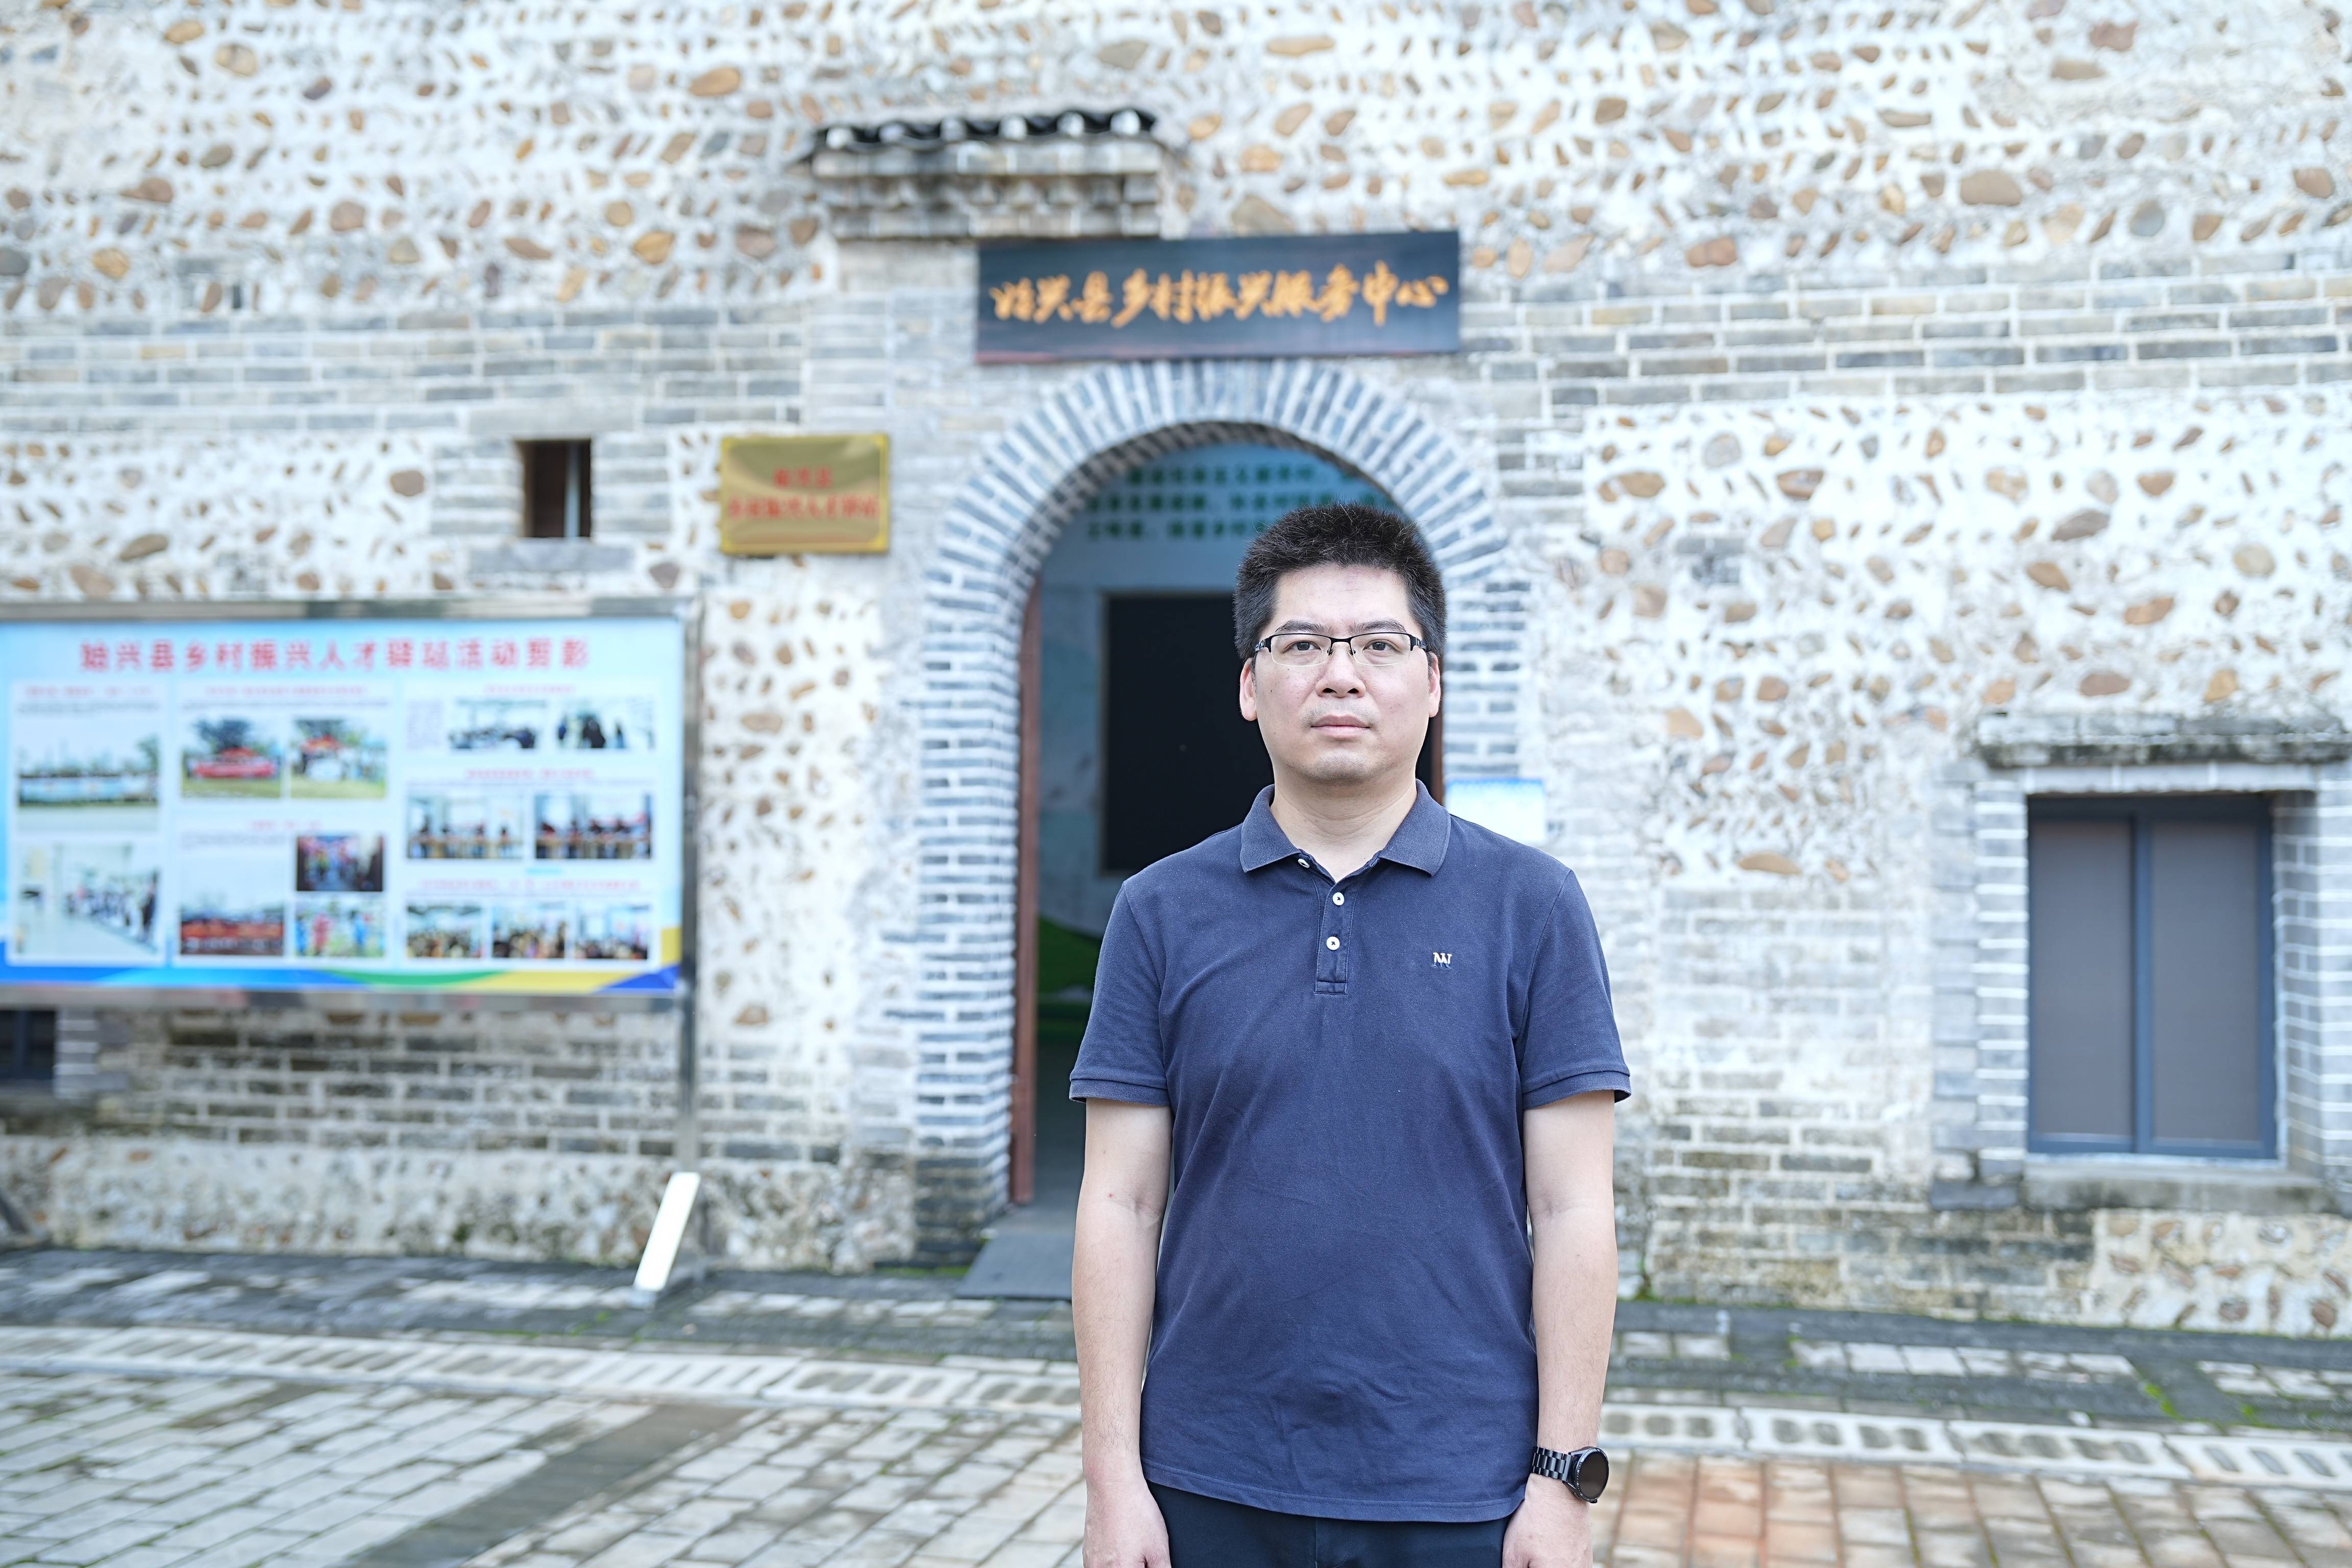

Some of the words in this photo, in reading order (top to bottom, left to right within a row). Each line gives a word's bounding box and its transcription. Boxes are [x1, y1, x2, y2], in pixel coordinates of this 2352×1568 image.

[80, 639, 589, 670] 始兴县乡村振兴人才驿站活动剪影
